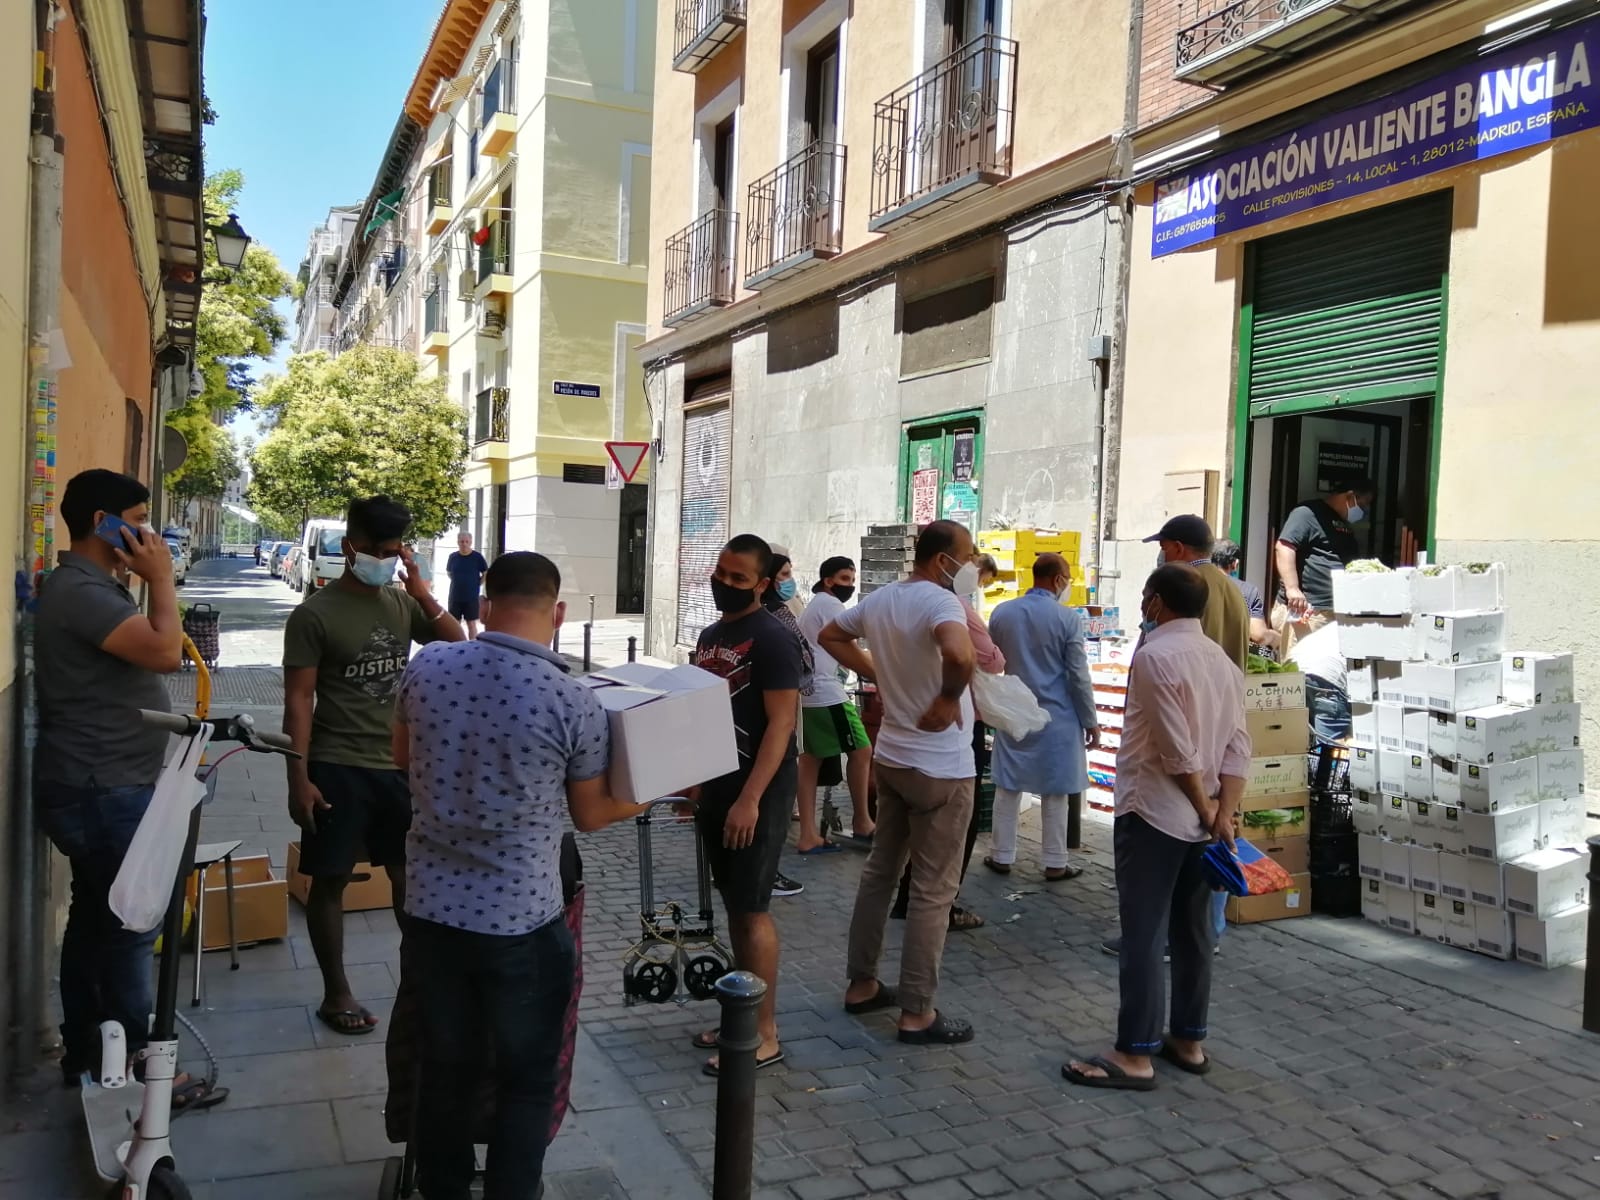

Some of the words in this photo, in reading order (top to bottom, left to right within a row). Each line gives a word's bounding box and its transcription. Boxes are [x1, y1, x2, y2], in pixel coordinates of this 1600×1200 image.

[1188, 132, 1317, 214] ASOCIACIÓN
[1323, 91, 1447, 169] VALIENTE
[1453, 41, 1592, 129] BANGLA
[1243, 200, 1271, 216] CALLE
[1271, 178, 1335, 208] PROVISIONES
[1365, 160, 1399, 180] LOCAL
[344, 656, 408, 678] DISTRIC
